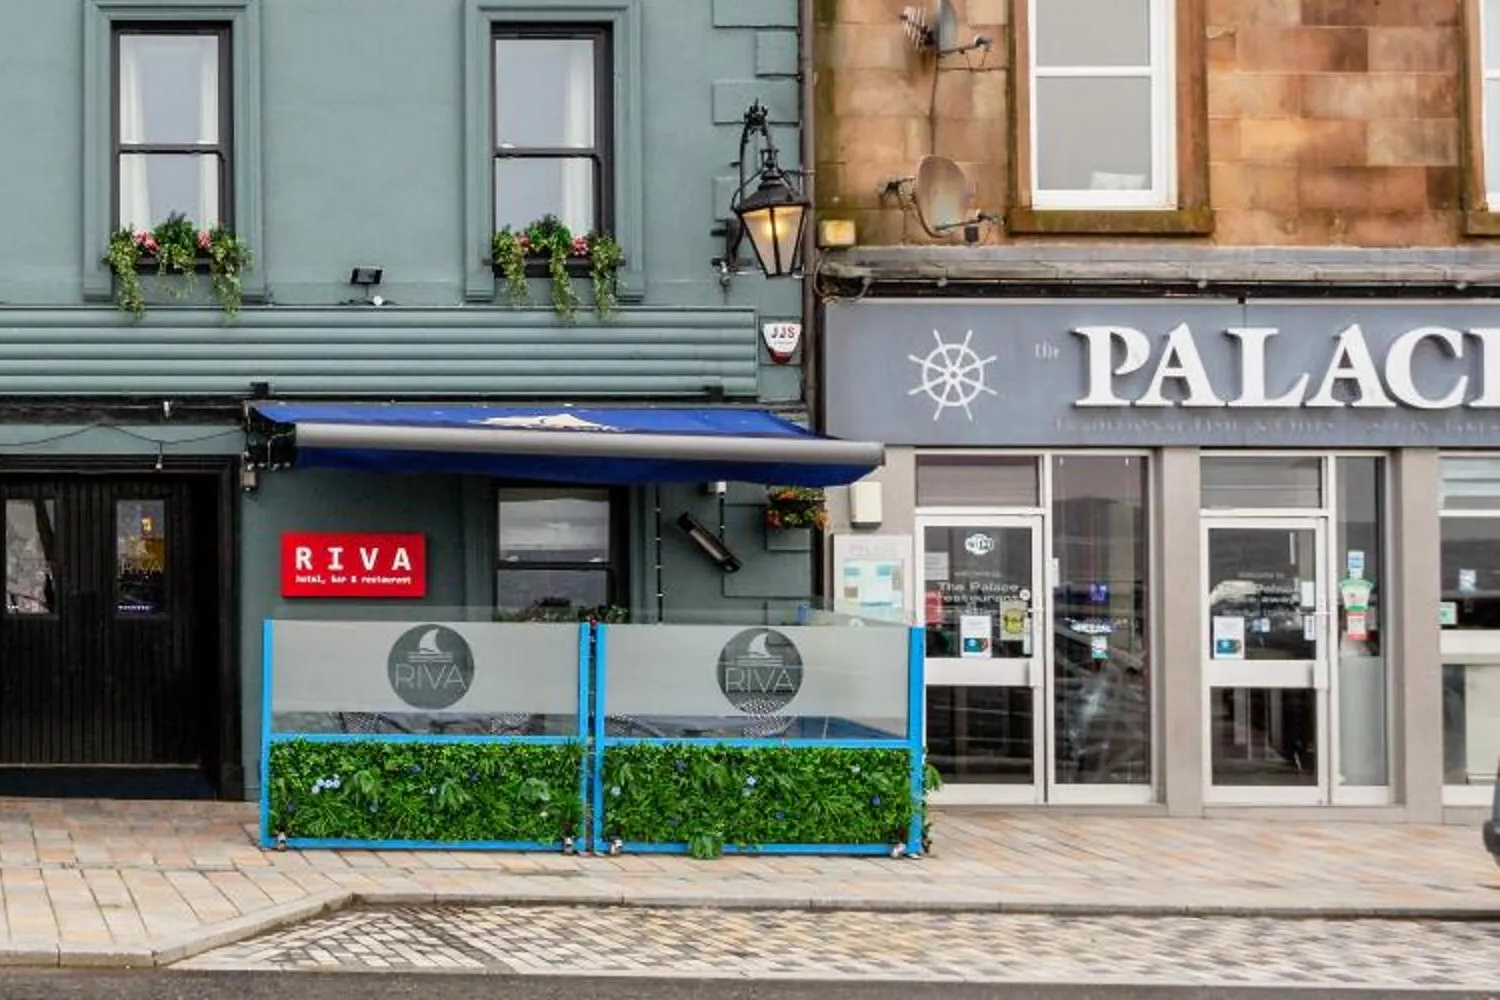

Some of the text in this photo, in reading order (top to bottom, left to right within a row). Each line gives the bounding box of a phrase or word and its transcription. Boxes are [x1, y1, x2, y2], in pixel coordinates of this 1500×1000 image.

[1034, 341, 1060, 362] the
[295, 546, 412, 571] RIVA
[394, 664, 466, 690] RIVA
[724, 666, 796, 694] RIVA
